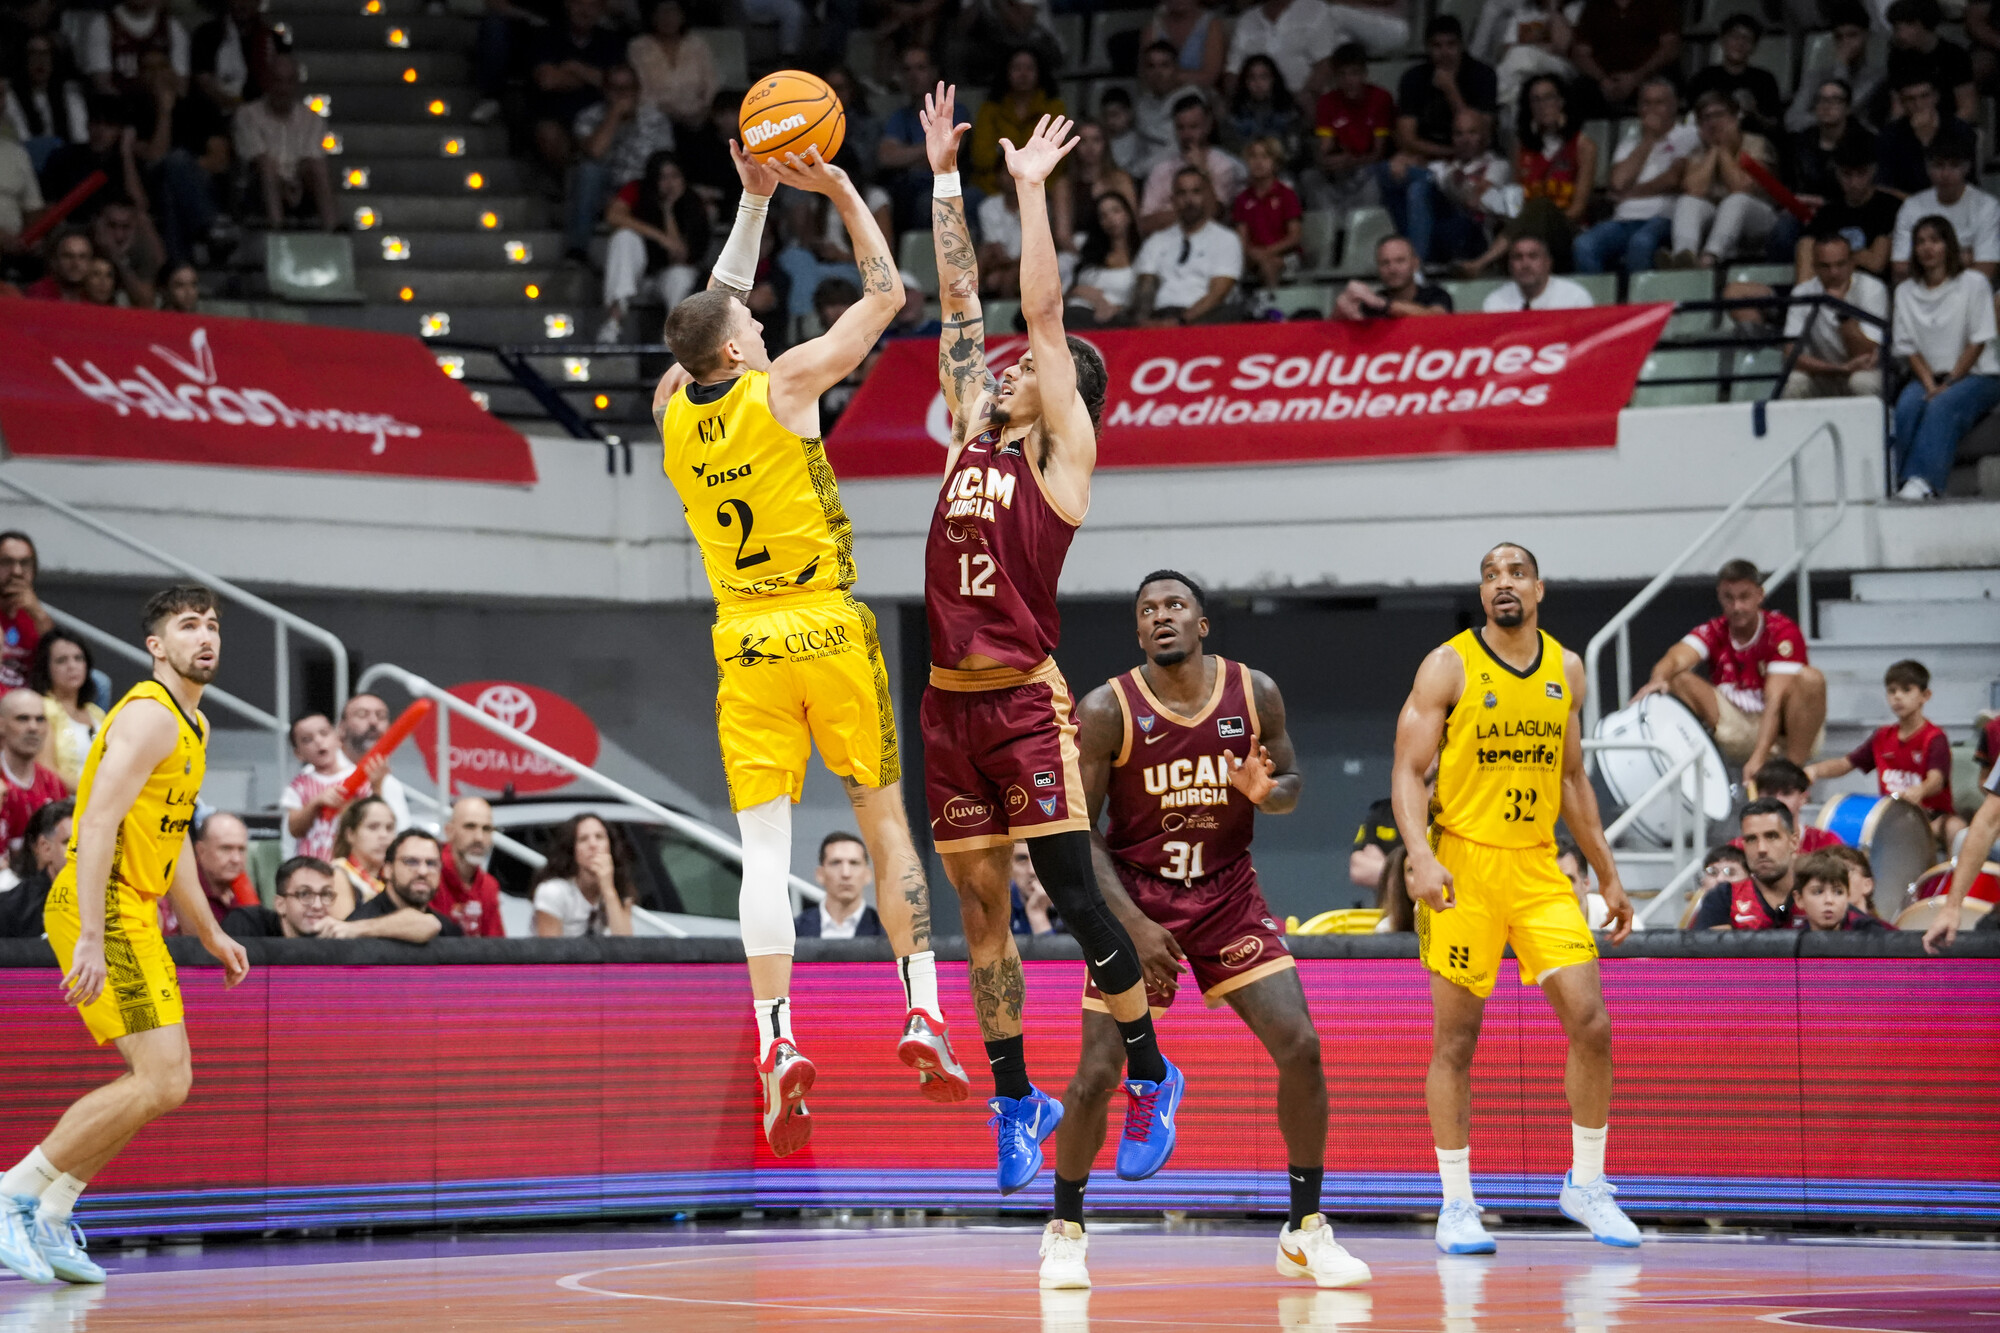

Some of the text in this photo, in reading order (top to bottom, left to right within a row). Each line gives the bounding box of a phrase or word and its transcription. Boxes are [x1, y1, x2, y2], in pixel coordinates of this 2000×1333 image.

[744, 113, 807, 147] Wilson
[1131, 341, 1570, 395] OC Soluciones
[1107, 381, 1551, 427] Medioambientales
[698, 413, 727, 444] GUY
[717, 499, 771, 570] 2
[958, 553, 996, 597] 12
[785, 625, 849, 654] CICAR
[790, 654, 815, 663] Canary
[817, 643, 841, 659] Islands
[1476, 719, 1562, 740] LA LAGUNA
[437, 746, 510, 771] OYOTA
[1477, 745, 1554, 764] tenerife
[1037, 776, 1051, 785] acb
[949, 805, 988, 820] Juver
[1160, 788, 1229, 810] MURCIA
[1504, 787, 1537, 822] 32
[1160, 841, 1205, 880] 31
[1225, 941, 1257, 964] Juver
